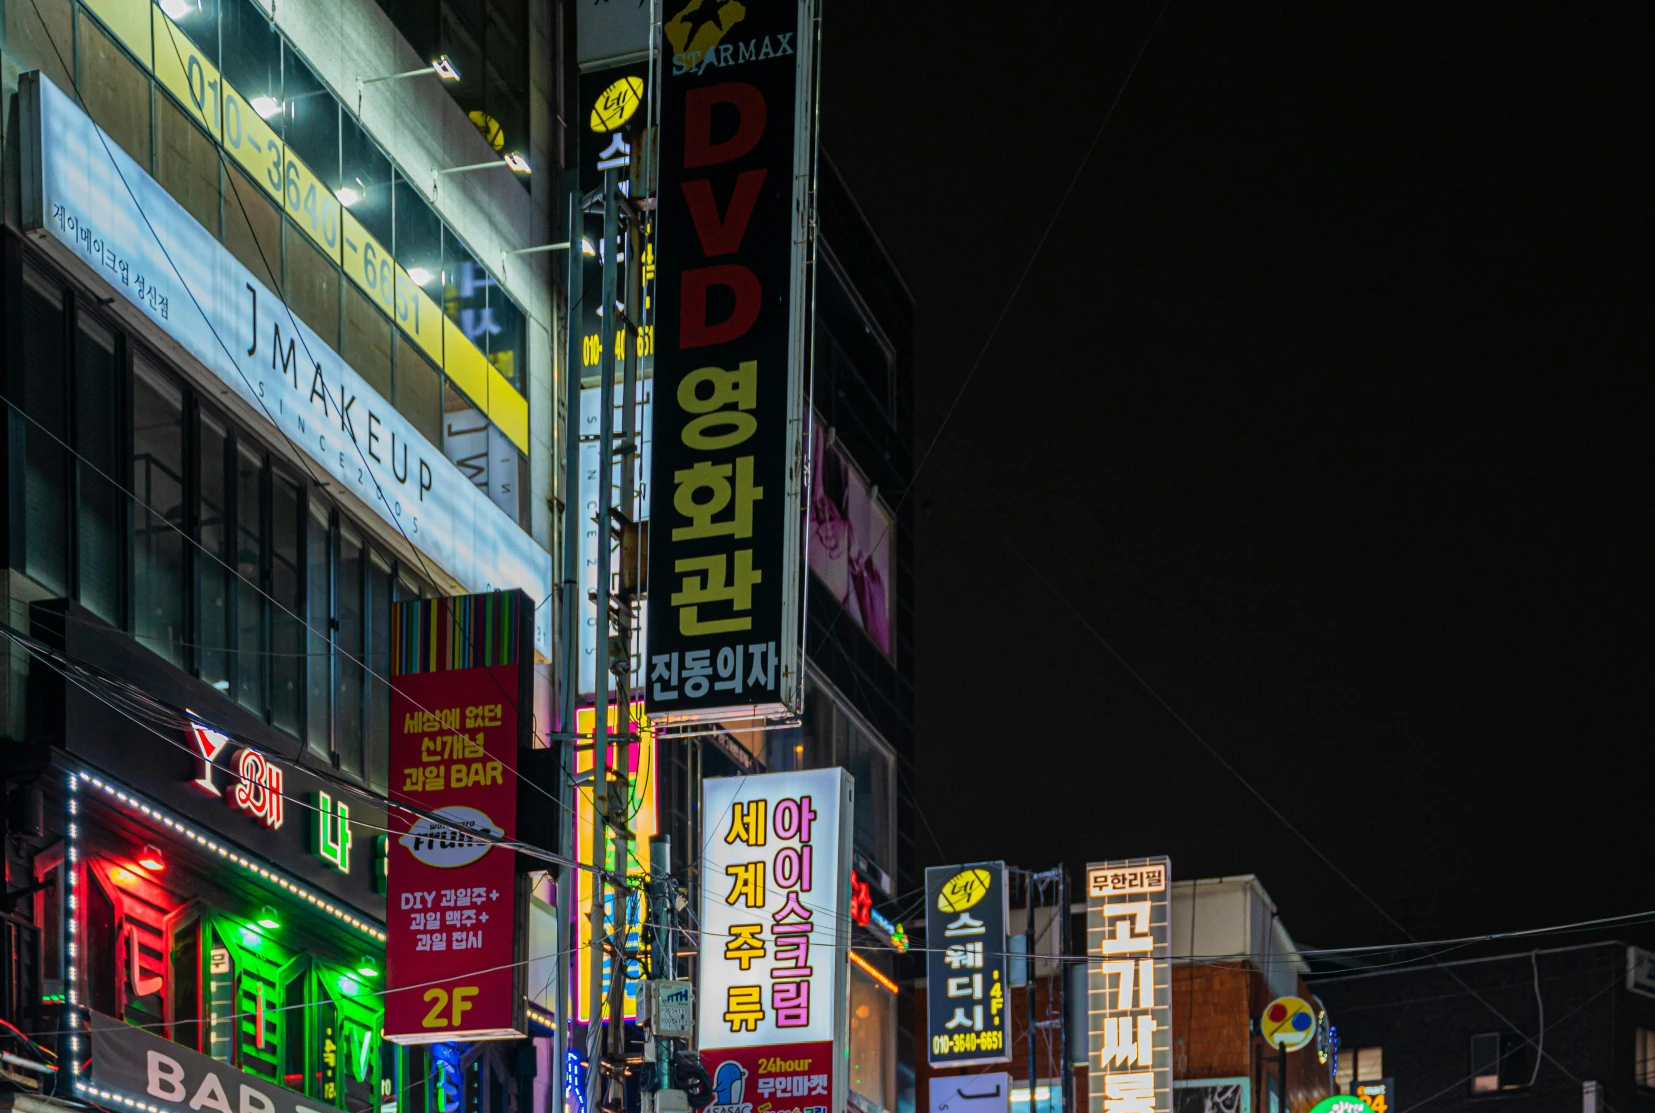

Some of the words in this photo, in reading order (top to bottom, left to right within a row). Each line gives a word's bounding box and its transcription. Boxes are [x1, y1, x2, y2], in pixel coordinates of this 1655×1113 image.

[672, 33, 794, 76] STARMAX
[679, 82, 768, 350] DVD
[671, 360, 763, 637] 영화관
[650, 641, 778, 702] 진동의자
[404, 708, 460, 734] 세상에
[465, 704, 502, 729] 없던
[421, 732, 485, 762] 신개념
[403, 765, 445, 792] 과일
[450, 761, 503, 788] BAR
[1092, 868, 1163, 892] 무한리필
[401, 891, 436, 910] DIY
[725, 799, 768, 1032] 세계주류
[771, 795, 816, 1028] 아이스크림
[409, 912, 441, 930] 과일
[416, 932, 447, 951] 과일
[452, 930, 483, 950] 접시
[944, 912, 986, 1032] 스웨디시
[422, 986, 479, 1028] 2F
[932, 1031, 1003, 1055] 010-3640-6651
[758, 1058, 813, 1075] 24hour
[757, 1074, 828, 1099] 무인마켓
